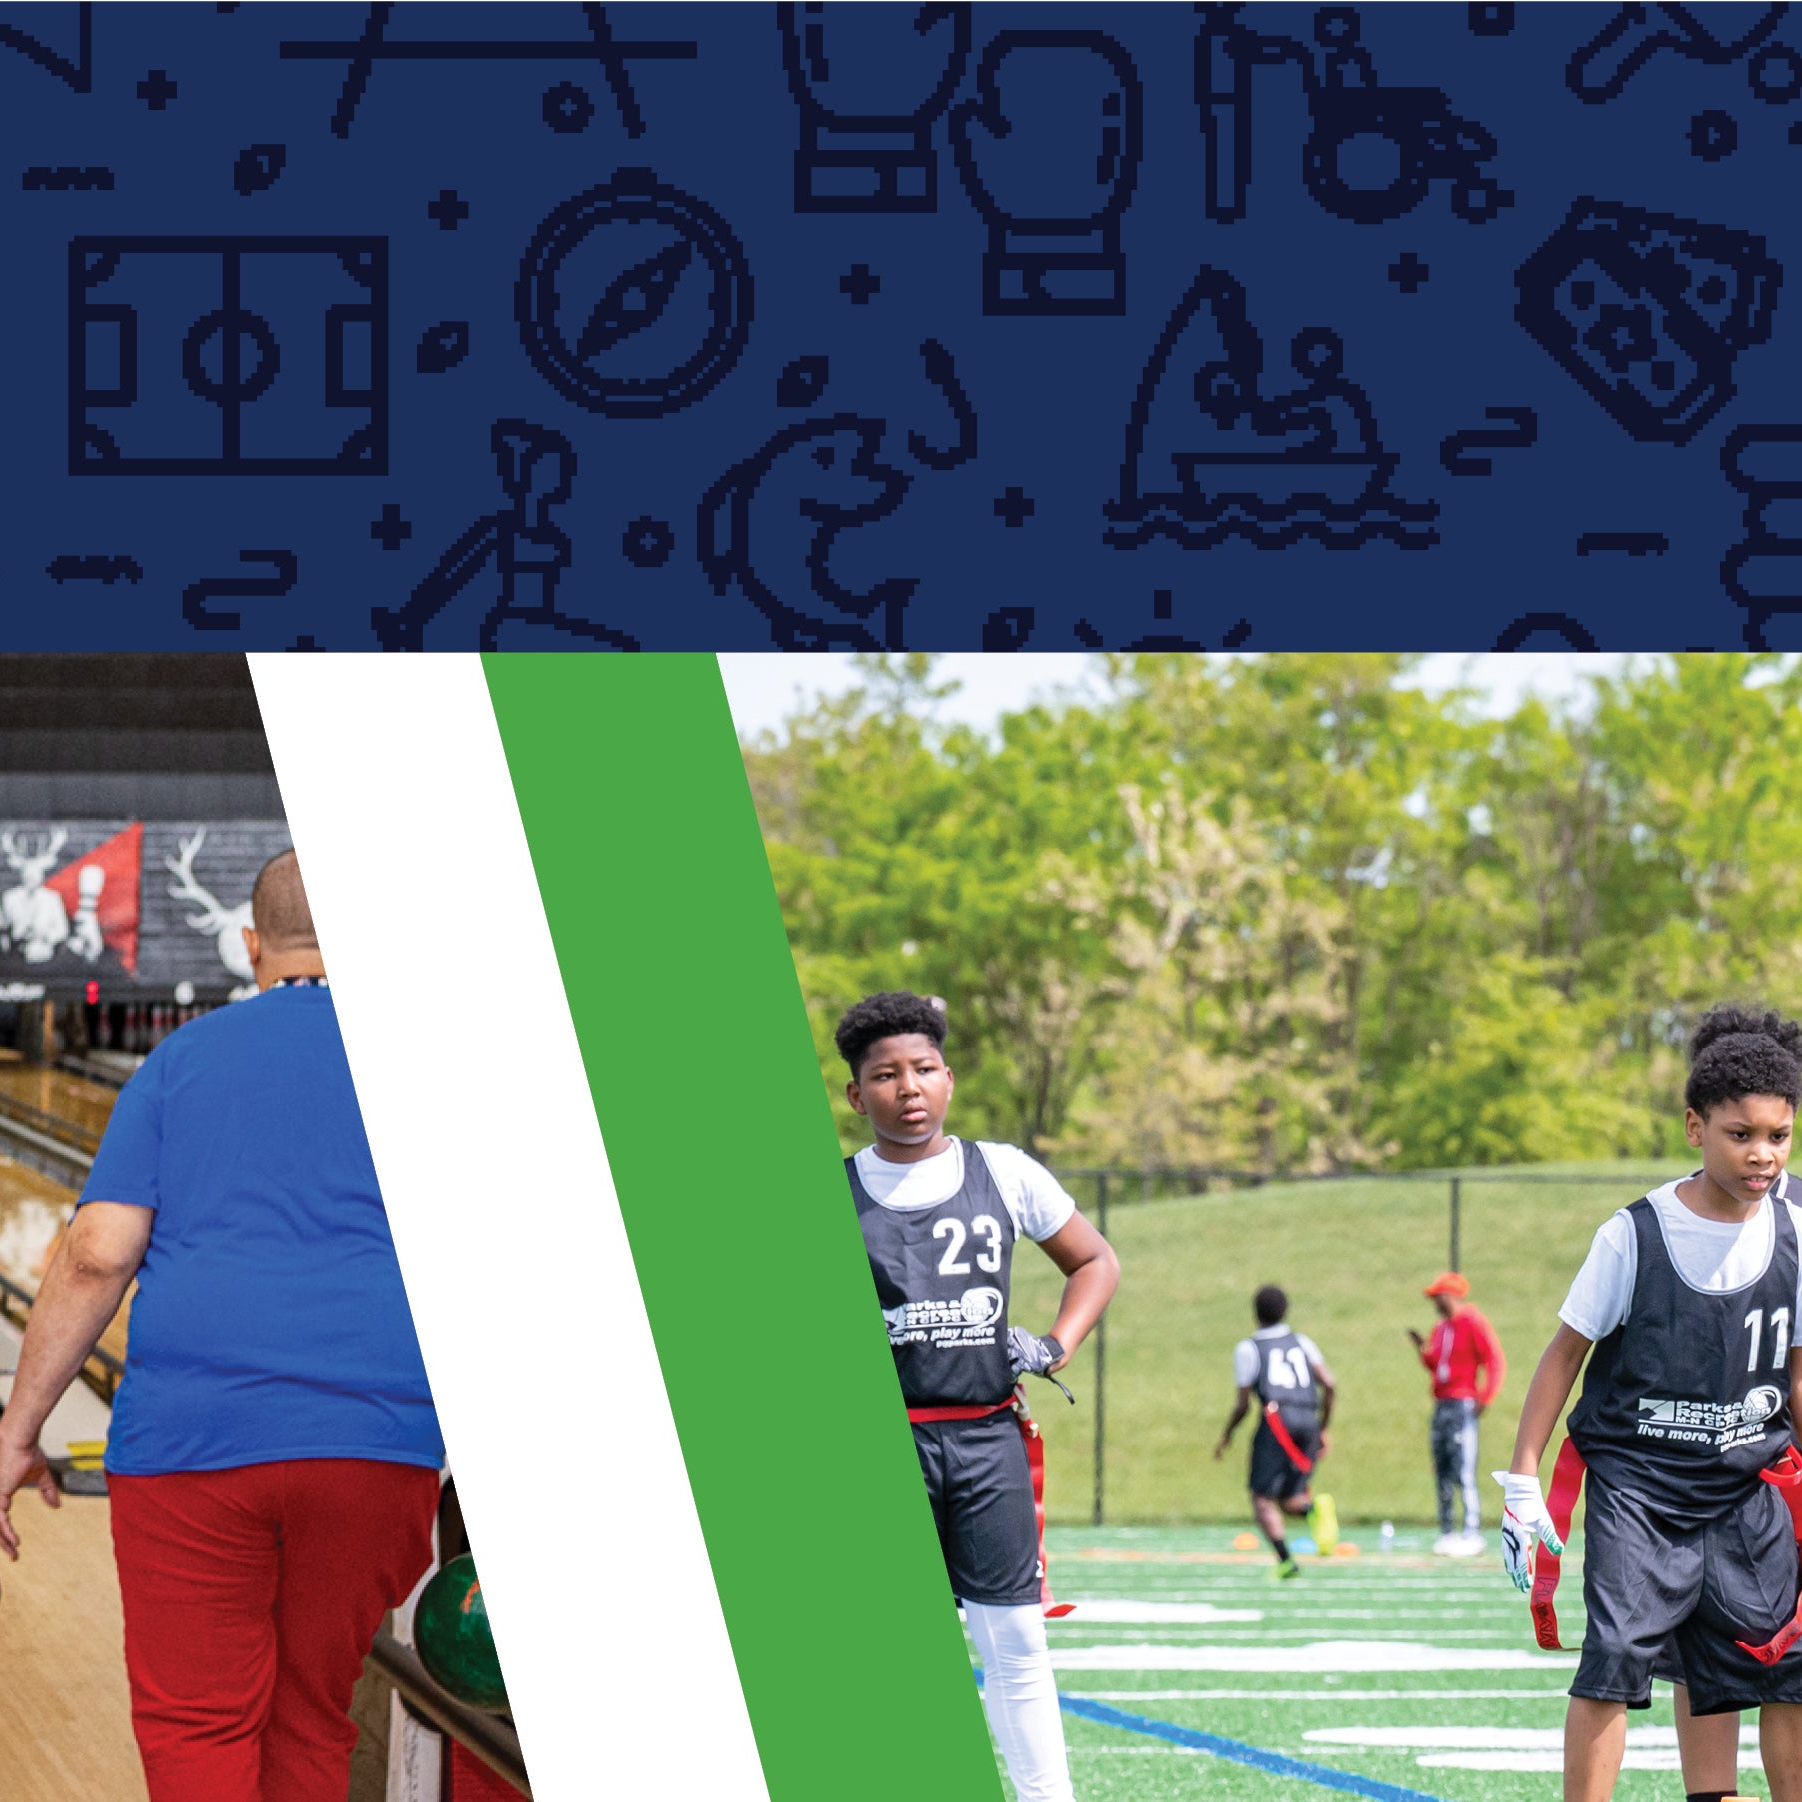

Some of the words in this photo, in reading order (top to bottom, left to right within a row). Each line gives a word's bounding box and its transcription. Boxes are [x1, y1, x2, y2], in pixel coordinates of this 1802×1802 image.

[932, 1214, 1002, 1276] 23
[905, 1300, 947, 1311] arks
[930, 1327, 961, 1341] play
[962, 1327, 995, 1337] more
[1744, 1308, 1789, 1371] 11
[1676, 1400, 1731, 1413] Parks
[1676, 1407, 1772, 1421] Recreation
[1637, 1424, 1665, 1438] live
[1668, 1428, 1711, 1445] more,
[1736, 1422, 1764, 1437] more
